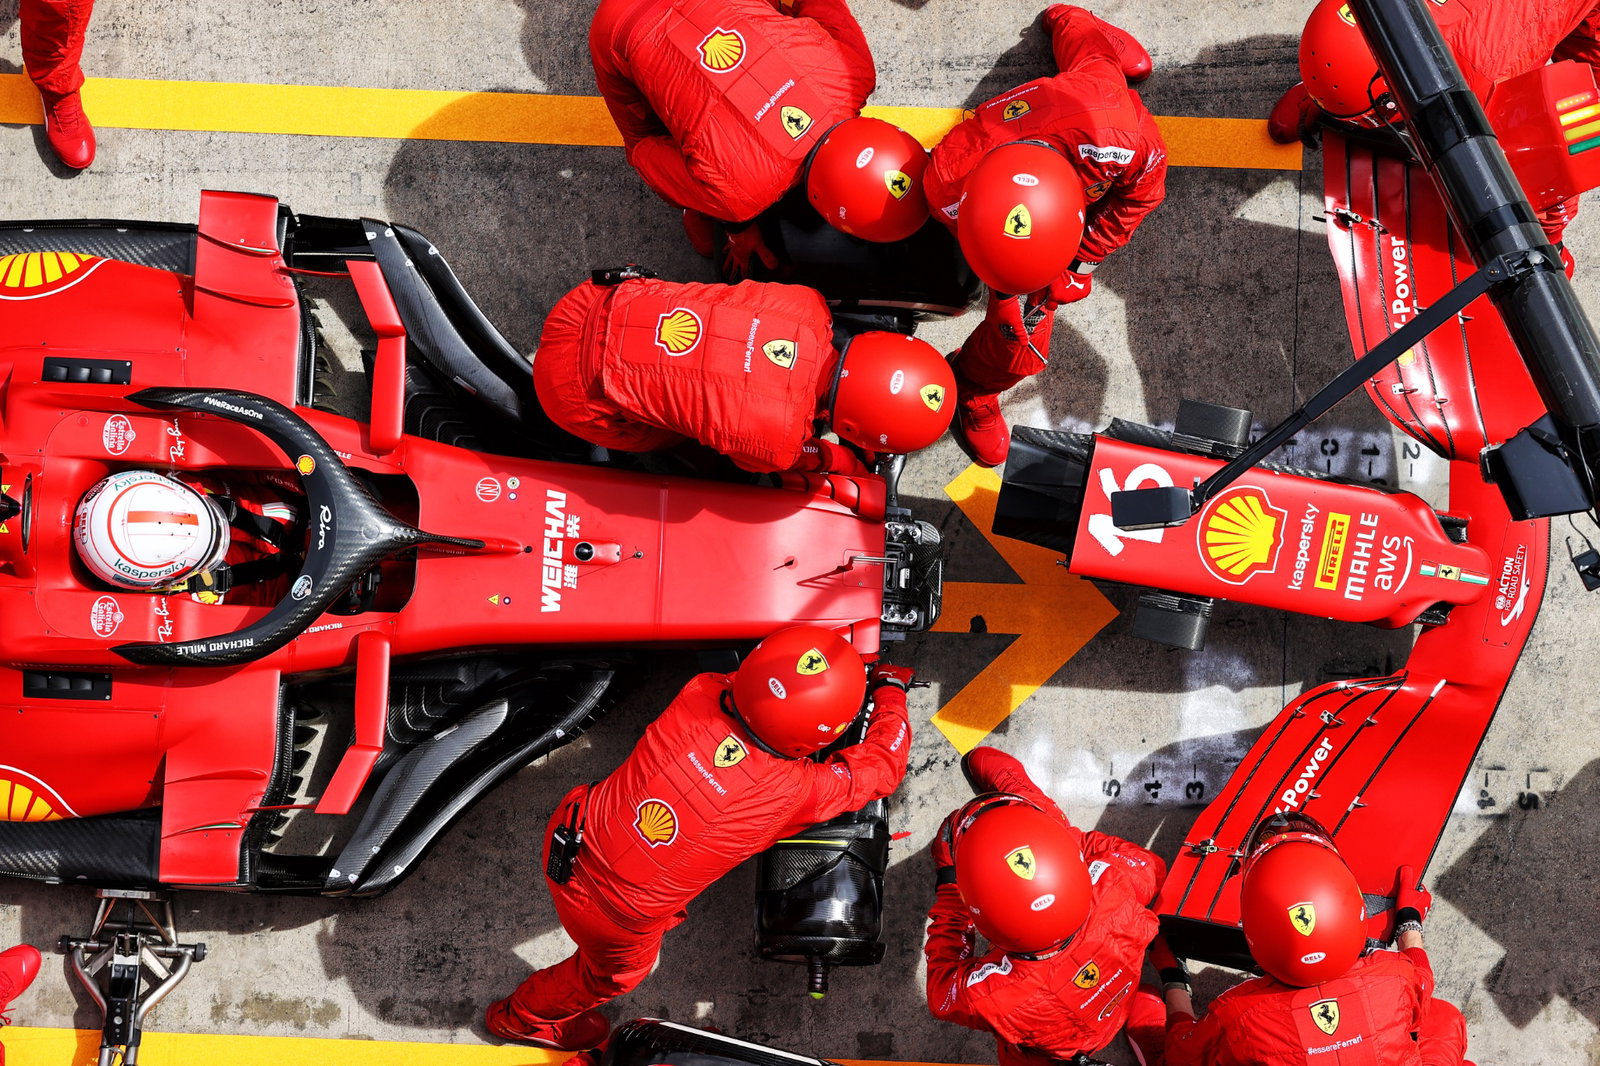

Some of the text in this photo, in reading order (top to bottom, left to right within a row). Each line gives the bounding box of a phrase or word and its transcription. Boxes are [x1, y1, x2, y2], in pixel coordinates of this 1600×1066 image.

[203, 396, 264, 420] #WeRaceAsOne
[109, 420, 119, 449] Galicia
[117, 420, 127, 451] Estrella
[166, 418, 186, 463] Ray-Ban
[1402, 442, 1420, 460] 2
[318, 503, 332, 550] Riva
[540, 489, 567, 613] WEICHAI
[1287, 503, 1320, 591] kaspersky
[1320, 519, 1345, 584] PIRELLI
[1344, 512, 1379, 601] MAHLE
[114, 558, 187, 579] kaspersky
[1374, 535, 1401, 591] aws
[1499, 556, 1515, 595] ACTION
[1504, 543, 1526, 611] FOR ROAD SAFETY
[96, 602, 106, 631] Galicia
[105, 602, 114, 633] Estrella
[155, 597, 173, 643] Ray-Ban
[309, 622, 343, 634] RICHARD
[176, 637, 254, 656] RICHARD MILLE
[770, 679, 784, 697] BELL
[1102, 778, 1121, 798] 5
[1145, 778, 1162, 799] 4
[1186, 780, 1205, 800] 3
[1033, 896, 1051, 909] BELL
[1303, 953, 1323, 963] BELL
[1307, 1034, 1363, 1056] #essereFerrari
